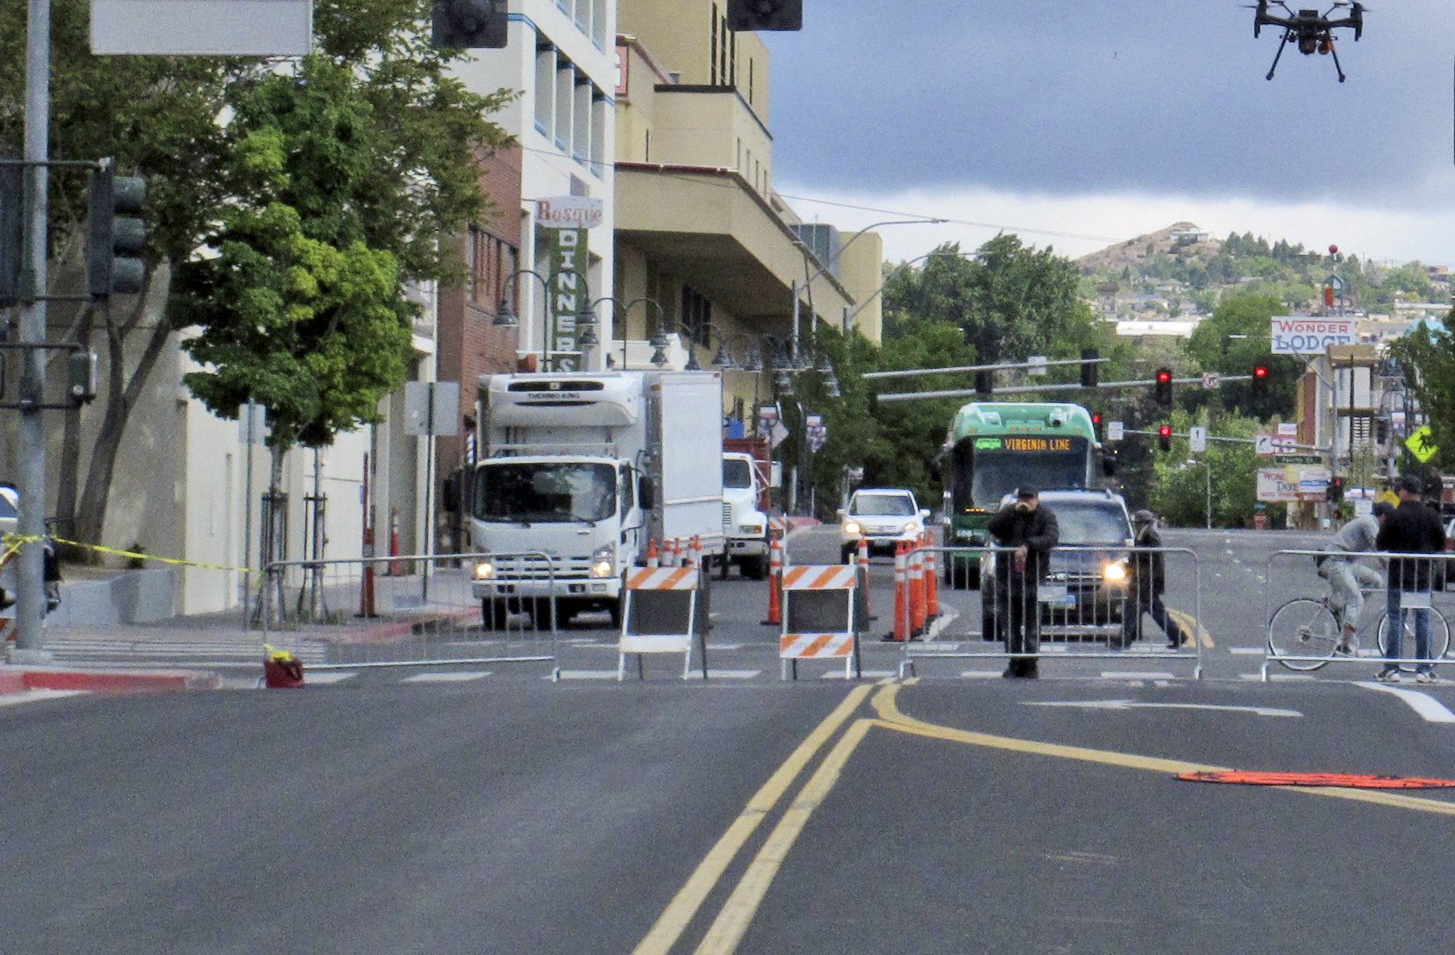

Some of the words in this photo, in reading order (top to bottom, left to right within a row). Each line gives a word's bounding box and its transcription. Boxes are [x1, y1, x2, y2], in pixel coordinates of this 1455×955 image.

[537, 200, 602, 222] Basque
[557, 230, 578, 372] DINNERS
[1280, 320, 1348, 333] WONDER
[1004, 439, 1047, 451] VIRGINIA
[1049, 439, 1070, 450] LINE
